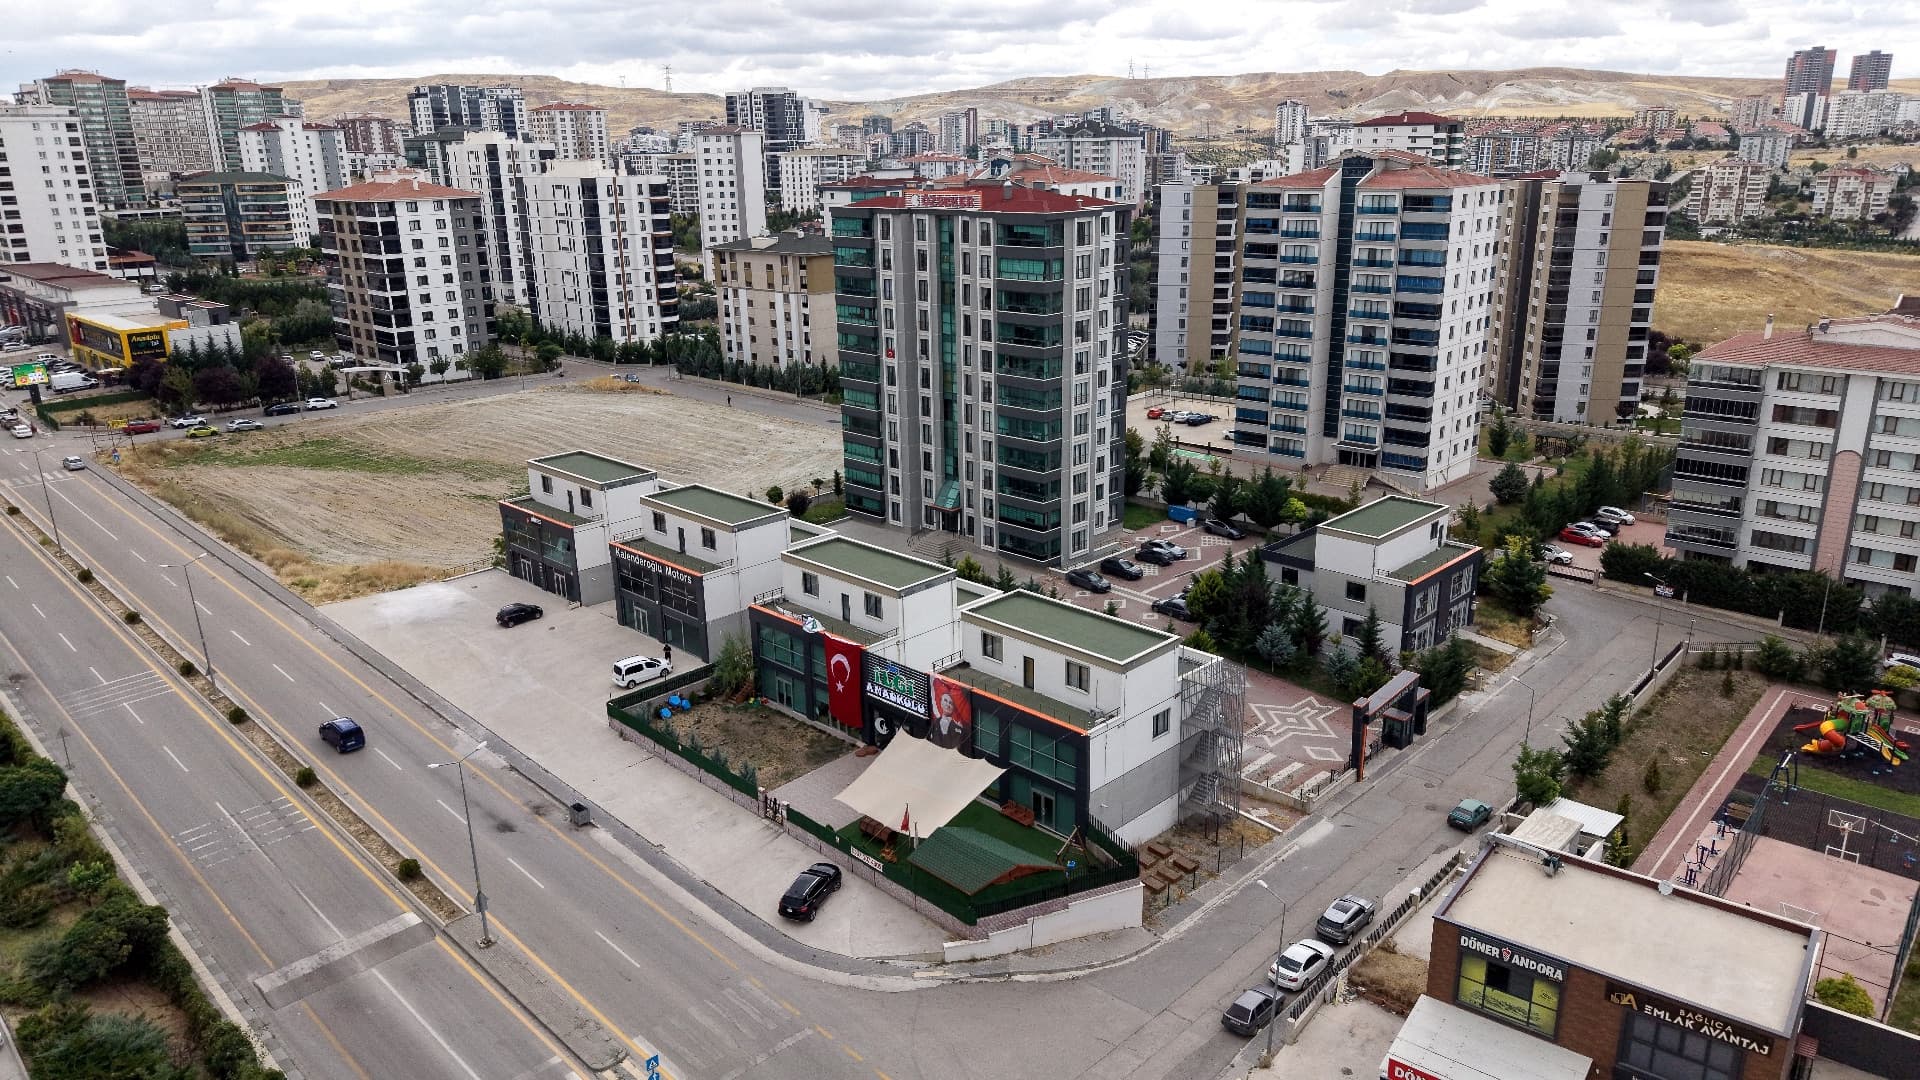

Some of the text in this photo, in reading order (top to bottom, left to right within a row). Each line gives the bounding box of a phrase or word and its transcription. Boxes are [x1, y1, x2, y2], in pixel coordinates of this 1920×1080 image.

[615, 547, 692, 584] Kalenderoğlu Motors
[1460, 936, 1563, 981] DÖNER ANDORA
[1644, 1004, 1769, 1055] EMLAK AVANTAJ
[1679, 1009, 1733, 1033] BAĞLICA
